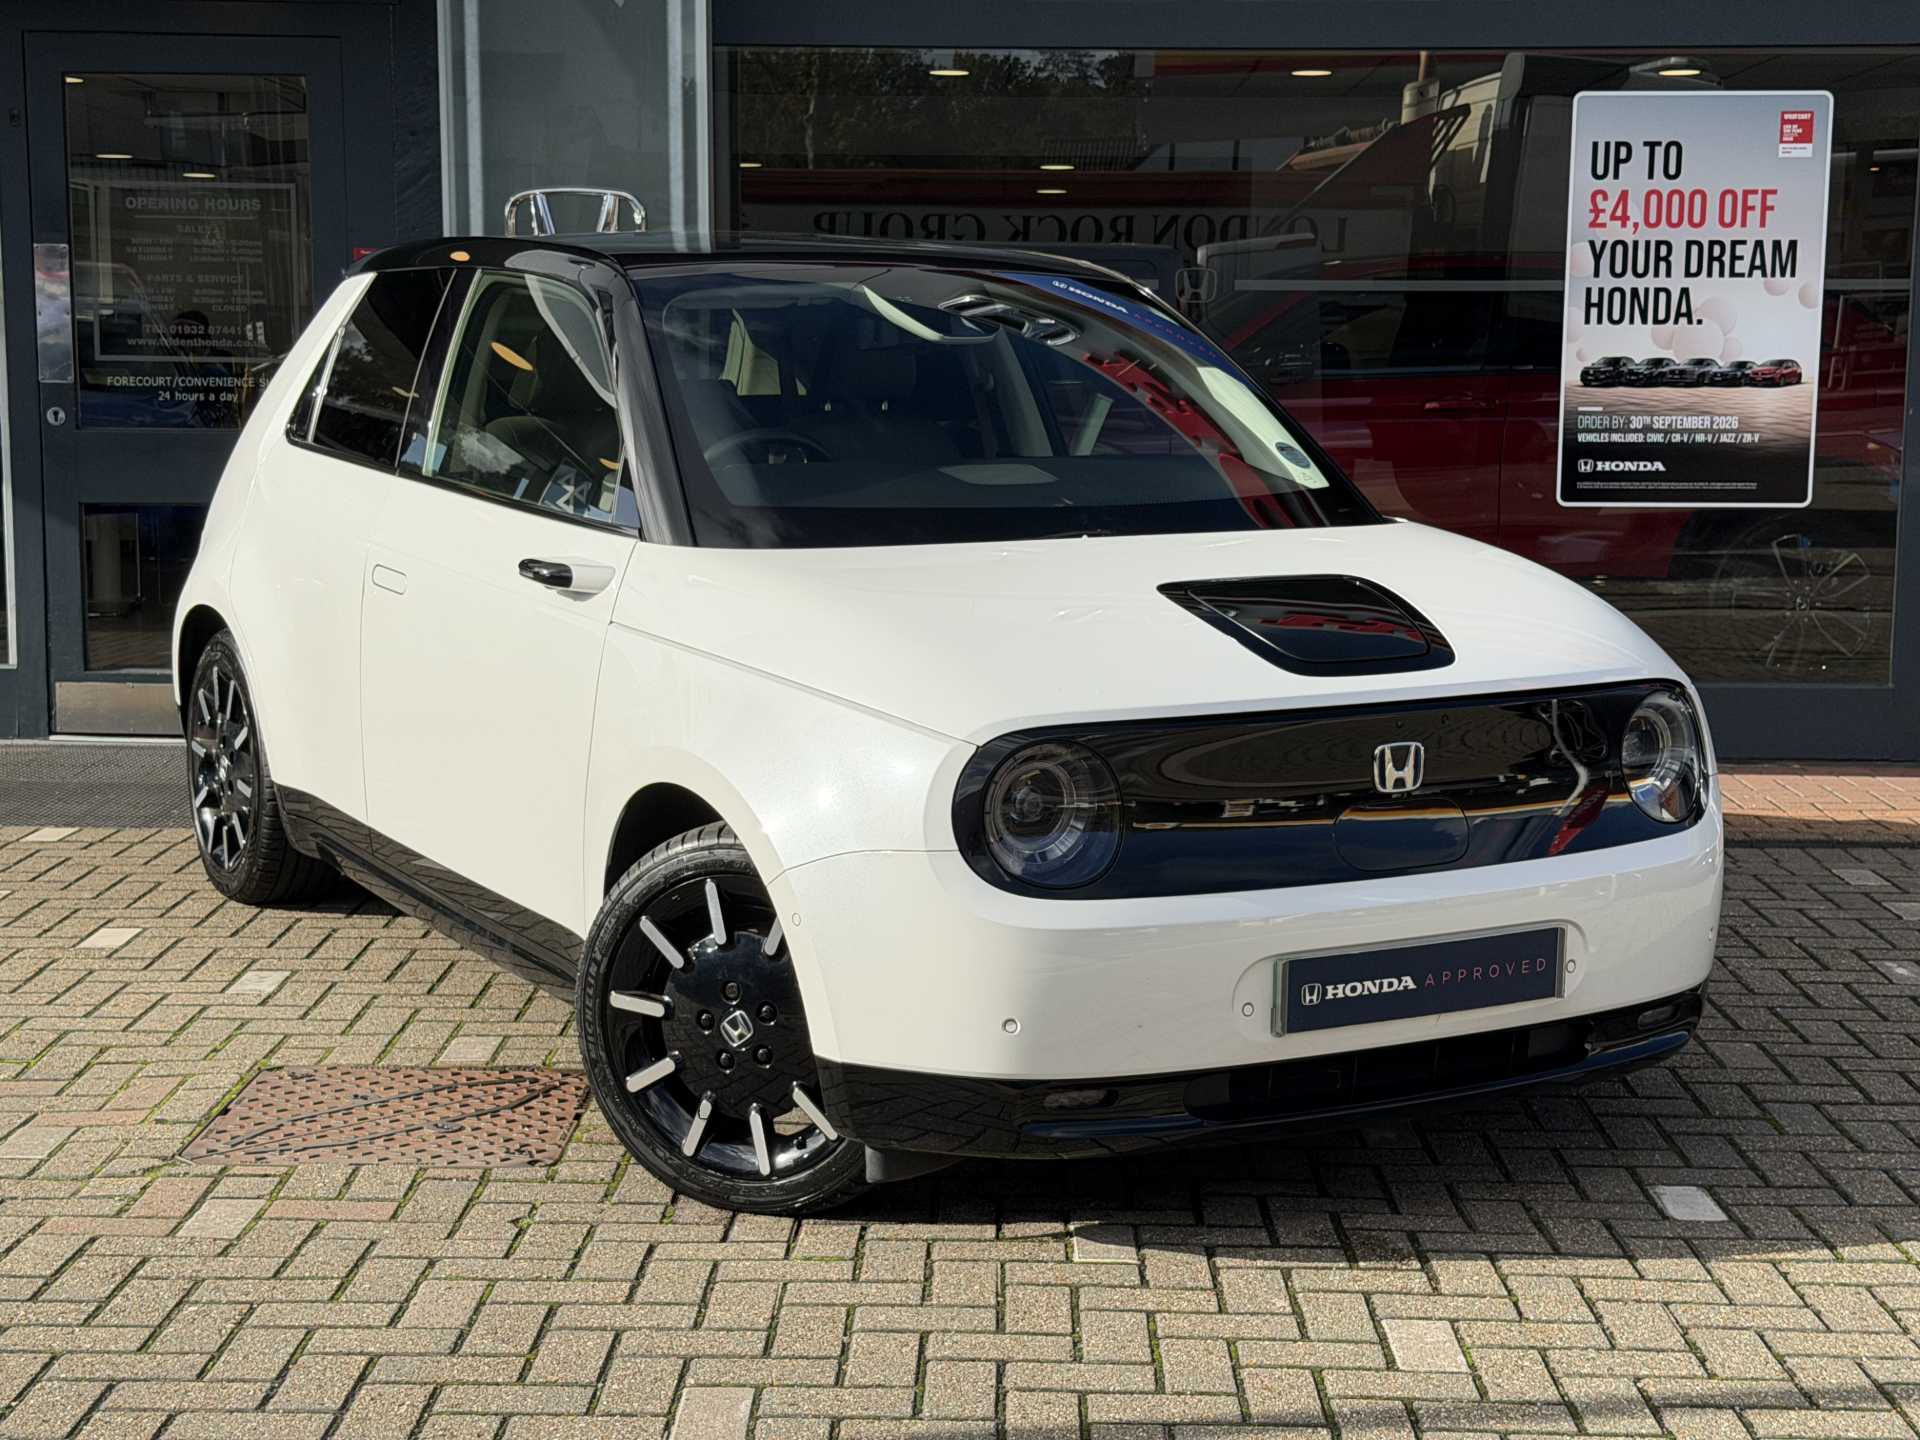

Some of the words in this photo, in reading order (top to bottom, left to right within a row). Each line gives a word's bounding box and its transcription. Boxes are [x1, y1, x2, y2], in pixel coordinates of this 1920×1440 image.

[1590, 140, 1633, 180] UP
[1643, 140, 1683, 180] TO
[125, 196, 199, 210] OPENING
[205, 197, 261, 211] HOURS
[1588, 188, 1707, 235] £4,000
[1717, 188, 1778, 229] OFF
[1587, 239, 1673, 279] YOUR
[1683, 239, 1798, 279] DREAM
[1584, 286, 1703, 325] HONDA.
[169, 324, 205, 335] 01932
[106, 376, 255, 388] FORECOURT/CONVENIENCE
[158, 391, 170, 401] 24
[175, 391, 205, 402] hours
[208, 393, 216, 402] a
[220, 391, 239, 403] day
[1577, 415, 1610, 429] ORDER
[1611, 415, 1628, 429] BY:
[1629, 415, 1651, 429] 30TH
[1652, 415, 1711, 429] SEPTEMBER
[1712, 415, 1739, 429] 2026
[1577, 432, 1610, 442] VEHICLES
[1610, 432, 1646, 442] INCLUDED:
[1646, 432, 1664, 442] CIVIC
[1719, 433, 1736, 443] JAZZ
[1595, 461, 1667, 472] HONDA
[1325, 975, 1417, 1000] HONDA
[1424, 957, 1547, 988] APPROVED
[583, 964, 600, 1059] MICHELIN
